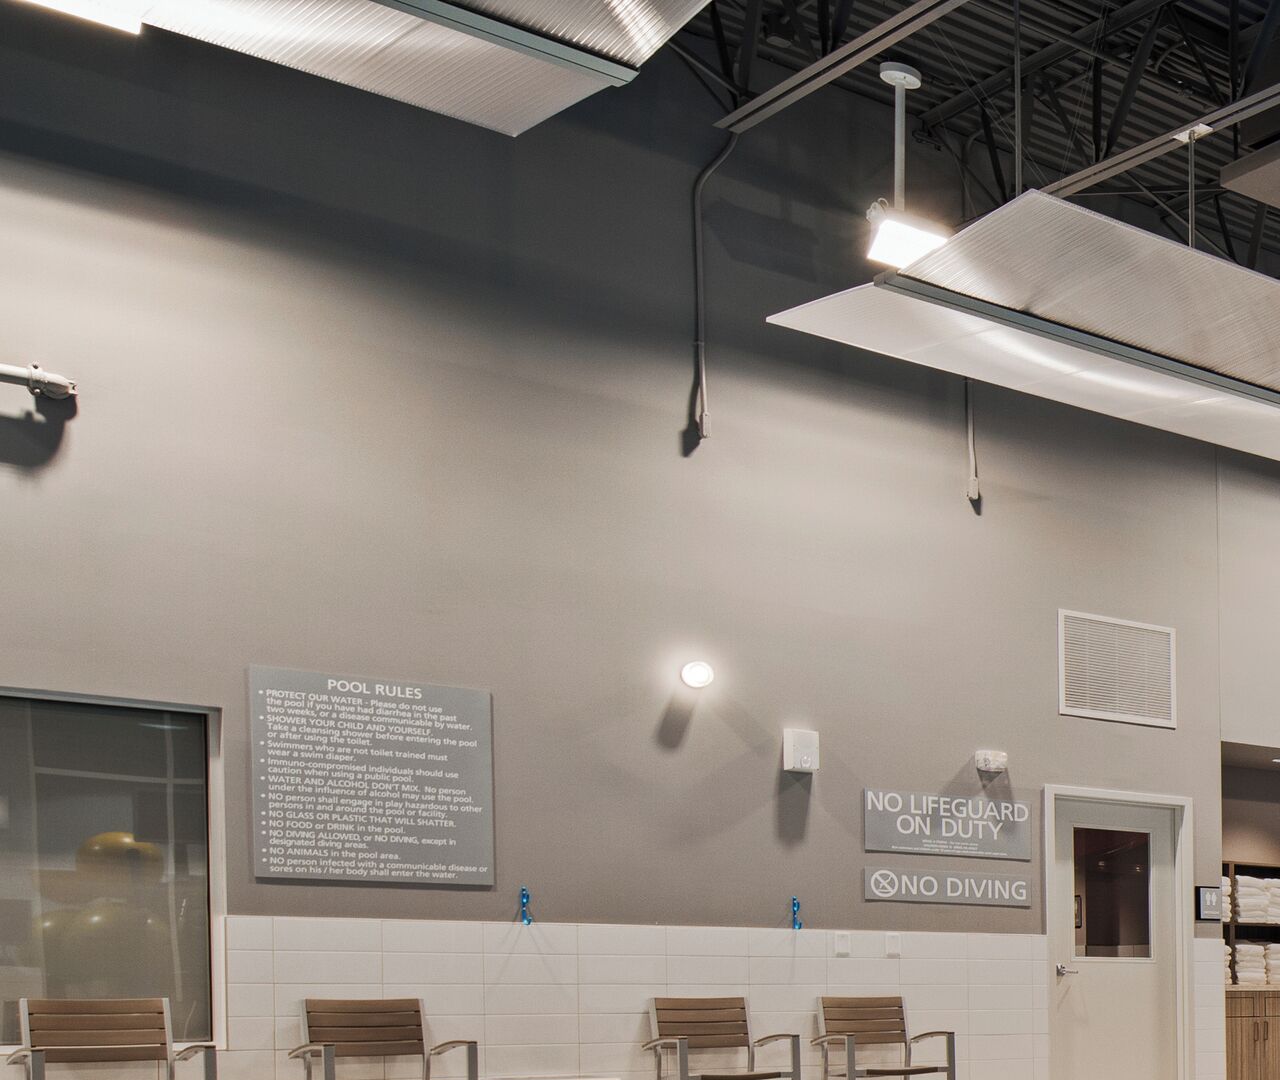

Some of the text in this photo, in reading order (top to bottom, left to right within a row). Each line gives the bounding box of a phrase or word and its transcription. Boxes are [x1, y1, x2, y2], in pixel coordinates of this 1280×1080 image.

[327, 679, 422, 699] POOL RULES
[266, 689, 305, 699] PROTECT
[308, 693, 328, 701] OUR
[330, 695, 362, 705] WATER
[370, 699, 396, 708] Please
[266, 714, 432, 736] SHOWER YOUR CHILD AND YOURSELF.
[267, 722, 288, 730] Take
[298, 725, 340, 736] cleansing
[341, 729, 372, 738] shower
[375, 732, 403, 740] before
[405, 736, 440, 745] entering
[304, 734, 327, 743] using
[268, 740, 312, 750] Swimmers
[325, 752, 356, 762] diaper.
[267, 757, 366, 771] Immuno-compromised
[369, 765, 413, 774] individuals
[331, 770, 354, 779] using
[268, 775, 301, 784] WATER
[326, 779, 369, 788] ALCOHOL
[371, 782, 398, 790] DON'T
[315, 786, 355, 795] influence
[385, 800, 402, 808] play
[405, 801, 446, 810] hazardous
[867, 792, 1028, 822] NO LIFEGUARD
[285, 811, 313, 819] GLASS
[332, 813, 366, 822] PLASTIC
[417, 818, 456, 827] SHATTER.
[417, 809, 447, 818] facility.
[896, 815, 1004, 840] ON DUTY
[287, 848, 327, 856] ANIMALS
[901, 876, 1027, 900] NO DIVING
